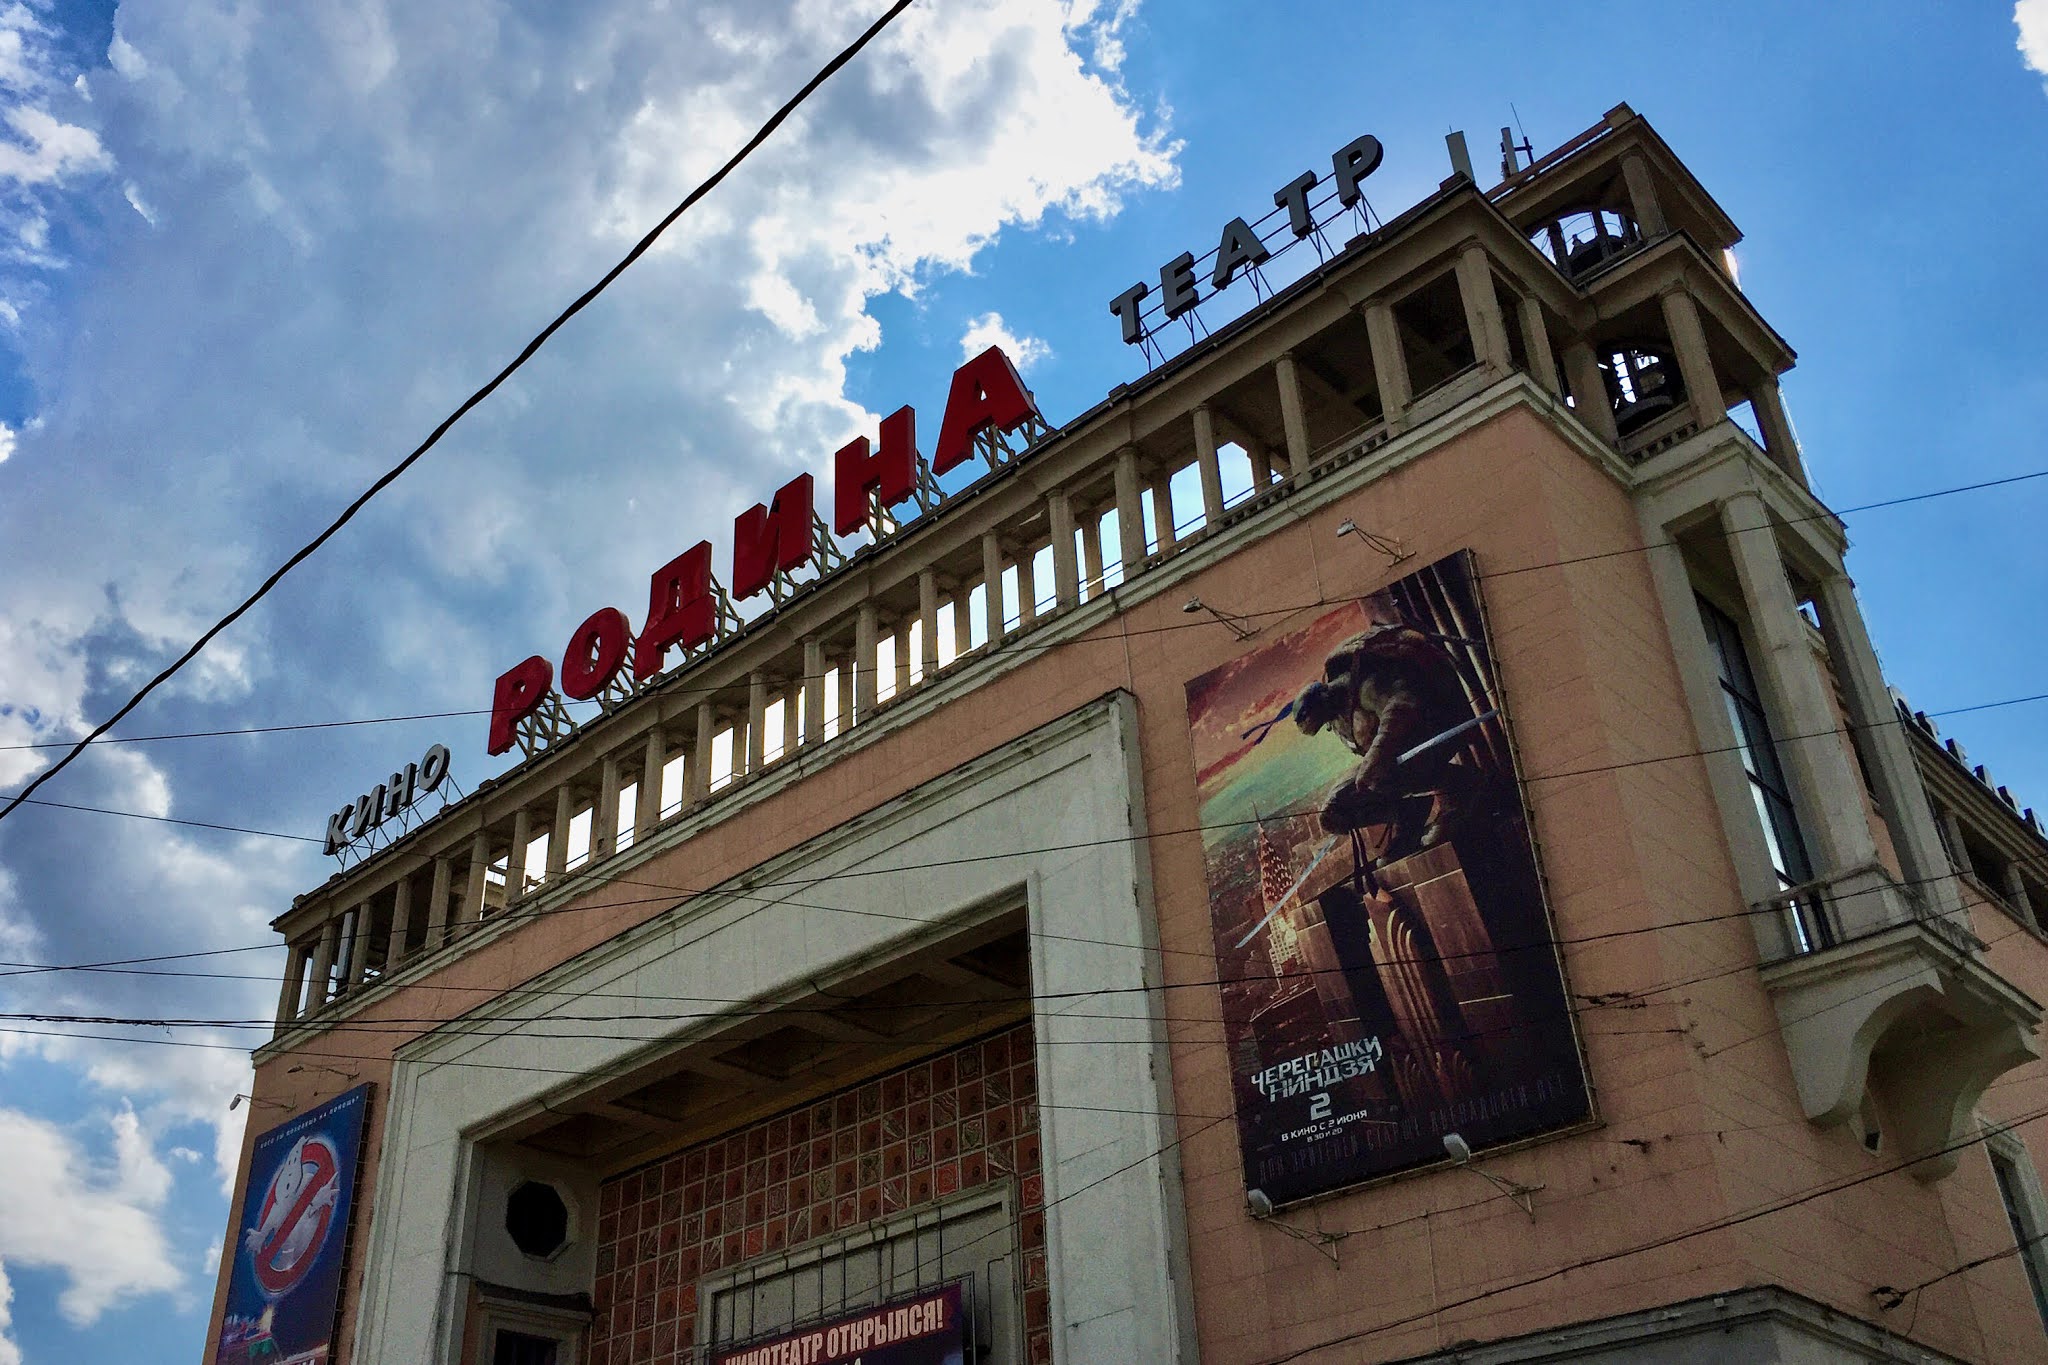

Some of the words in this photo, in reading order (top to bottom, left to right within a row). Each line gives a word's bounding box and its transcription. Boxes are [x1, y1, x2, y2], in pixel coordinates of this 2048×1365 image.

[323, 744, 450, 856] КИНО
[487, 345, 1037, 756] РОДИНА
[1109, 134, 1384, 345] ТЕАТР
[1251, 1035, 1382, 1095] ЧЕРЕПАШКИ
[1269, 1055, 1375, 1102] НИНДЗЯ
[1281, 1132, 1289, 1141] В
[1290, 1125, 1317, 1139] КИНО
[1319, 1121, 1326, 1130] С
[1328, 1119, 1335, 1128] 2
[1336, 1109, 1368, 1125] ИЮНЯ
[1309, 1092, 1332, 1120] 2
[725, 1333, 823, 1365] НОТЕАТР
[827, 1298, 944, 1359] ОТКРЫЛСЯ!
